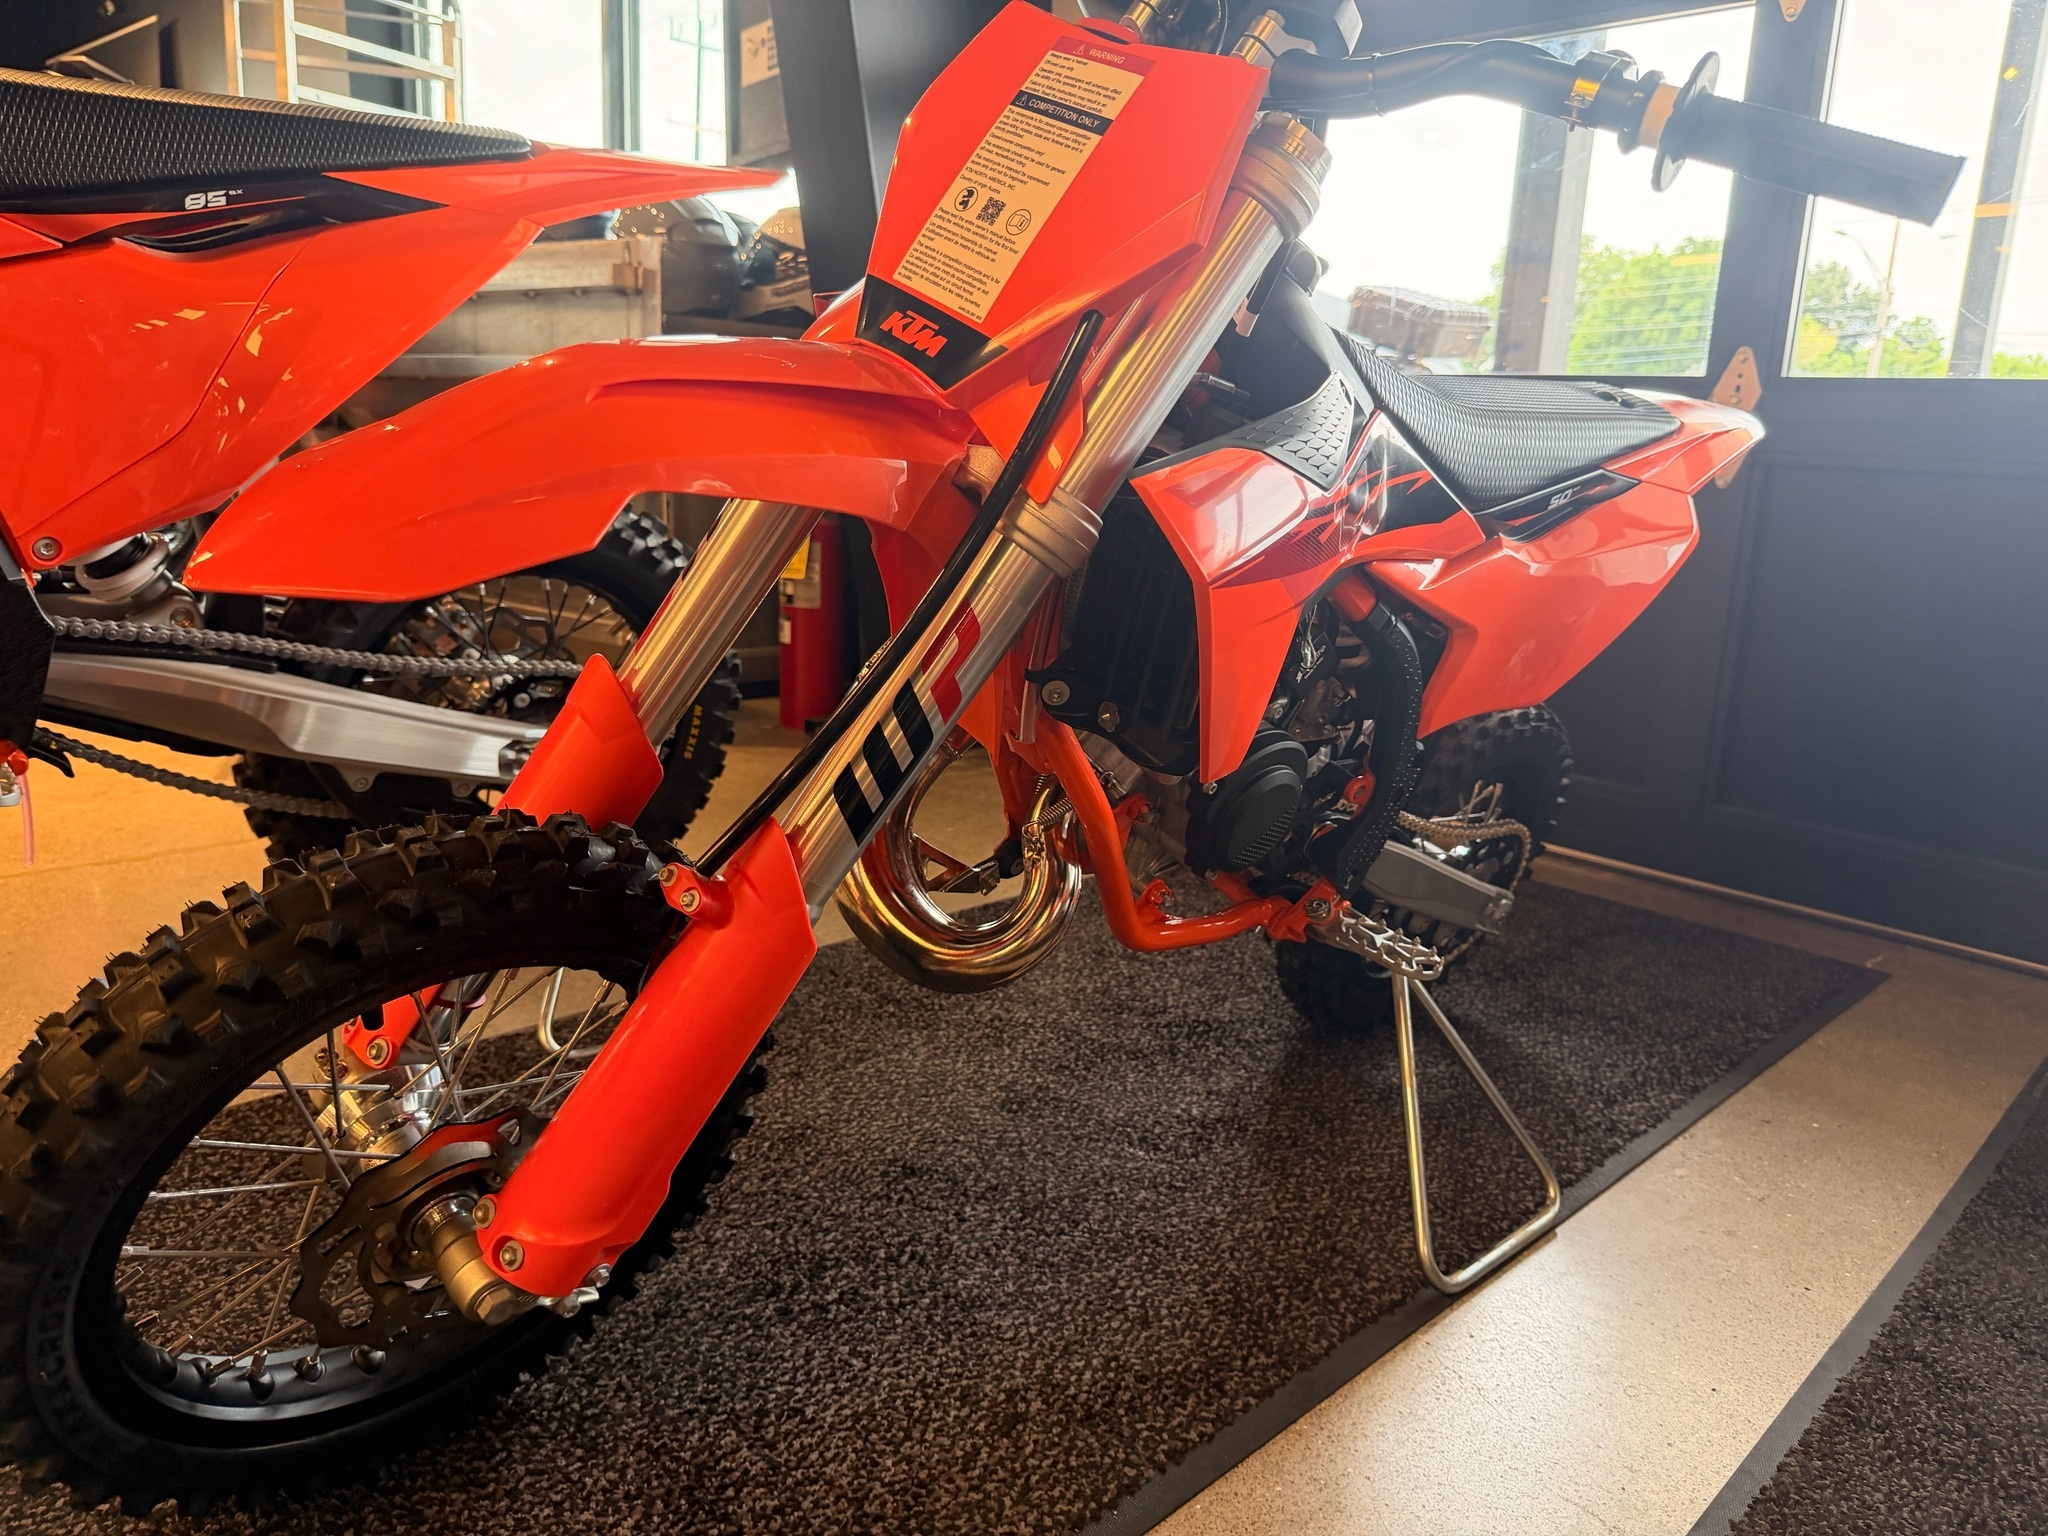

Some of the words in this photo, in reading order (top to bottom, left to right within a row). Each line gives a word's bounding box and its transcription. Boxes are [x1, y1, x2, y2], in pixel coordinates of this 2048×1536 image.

[1089, 49, 1125, 63] WARNING
[1063, 75, 1084, 84] passengers
[1091, 83, 1110, 92] adversely
[1056, 89, 1077, 98] instructions
[1029, 99, 1078, 120] COMPETITION
[1078, 116, 1100, 127] ONLY
[1086, 106, 1102, 114] carefully.
[999, 120, 1019, 130] street-riding
[1051, 138, 1064, 146] federal
[1005, 130, 1024, 139] prohibited.
[1015, 112, 1034, 120] motorcycle
[1044, 122, 1069, 133] closed-course
[1069, 131, 1091, 140] competition
[1032, 125, 1052, 134] motorcycle
[1056, 133, 1071, 141] off-road
[989, 133, 1014, 144] Closed-course
[1014, 143, 1035, 152] competition
[992, 143, 1011, 153] motorcycle
[980, 146, 994, 154] off-road,
[995, 152, 1016, 162] recreational
[974, 170, 988, 178] NORTH
[988, 176, 1006, 187] AMERICA,
[982, 157, 1001, 167] motorcycle
[1005, 166, 1021, 175] intended
[1027, 175, 1050, 186] experienced
[1008, 174, 1028, 185] beginners!
[960, 174, 973, 183] Country
[988, 186, 1001, 194] Austria
[185, 190, 227, 210] 85
[934, 214, 946, 222] putting
[972, 231, 988, 240] operation
[1009, 247, 1019, 255] time!
[938, 207, 950, 215] Please
[975, 224, 989, 233] owner's
[989, 231, 1004, 239] manual
[1003, 236, 1016, 245] before
[880, 310, 948, 358] KTM
[1548, 489, 1573, 510] 50
[684, 704, 703, 759] MAXXIS
